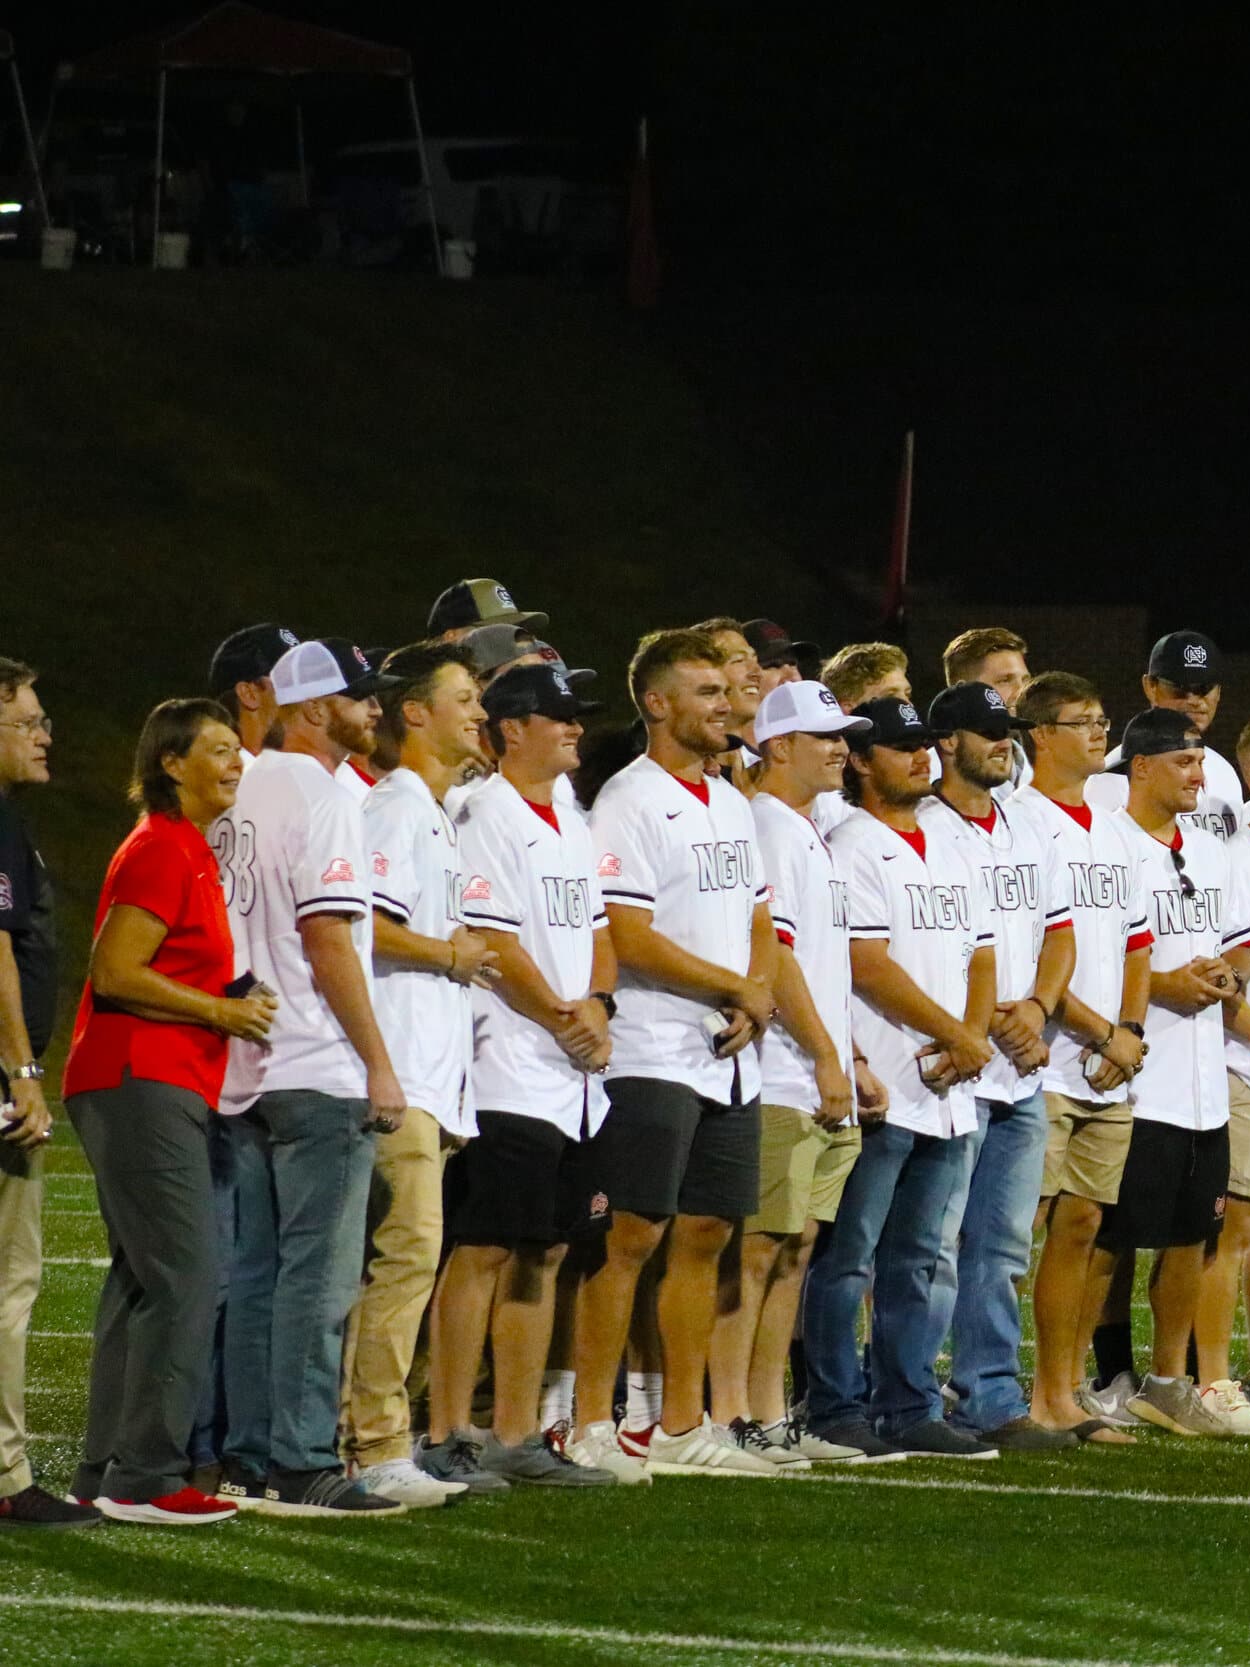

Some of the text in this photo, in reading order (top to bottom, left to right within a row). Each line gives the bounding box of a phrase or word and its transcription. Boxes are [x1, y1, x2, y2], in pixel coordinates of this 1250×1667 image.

[691, 840, 752, 892] NGU
[1068, 862, 1129, 911] NGU
[904, 883, 971, 931] NGU
[1153, 888, 1222, 936] NGU
